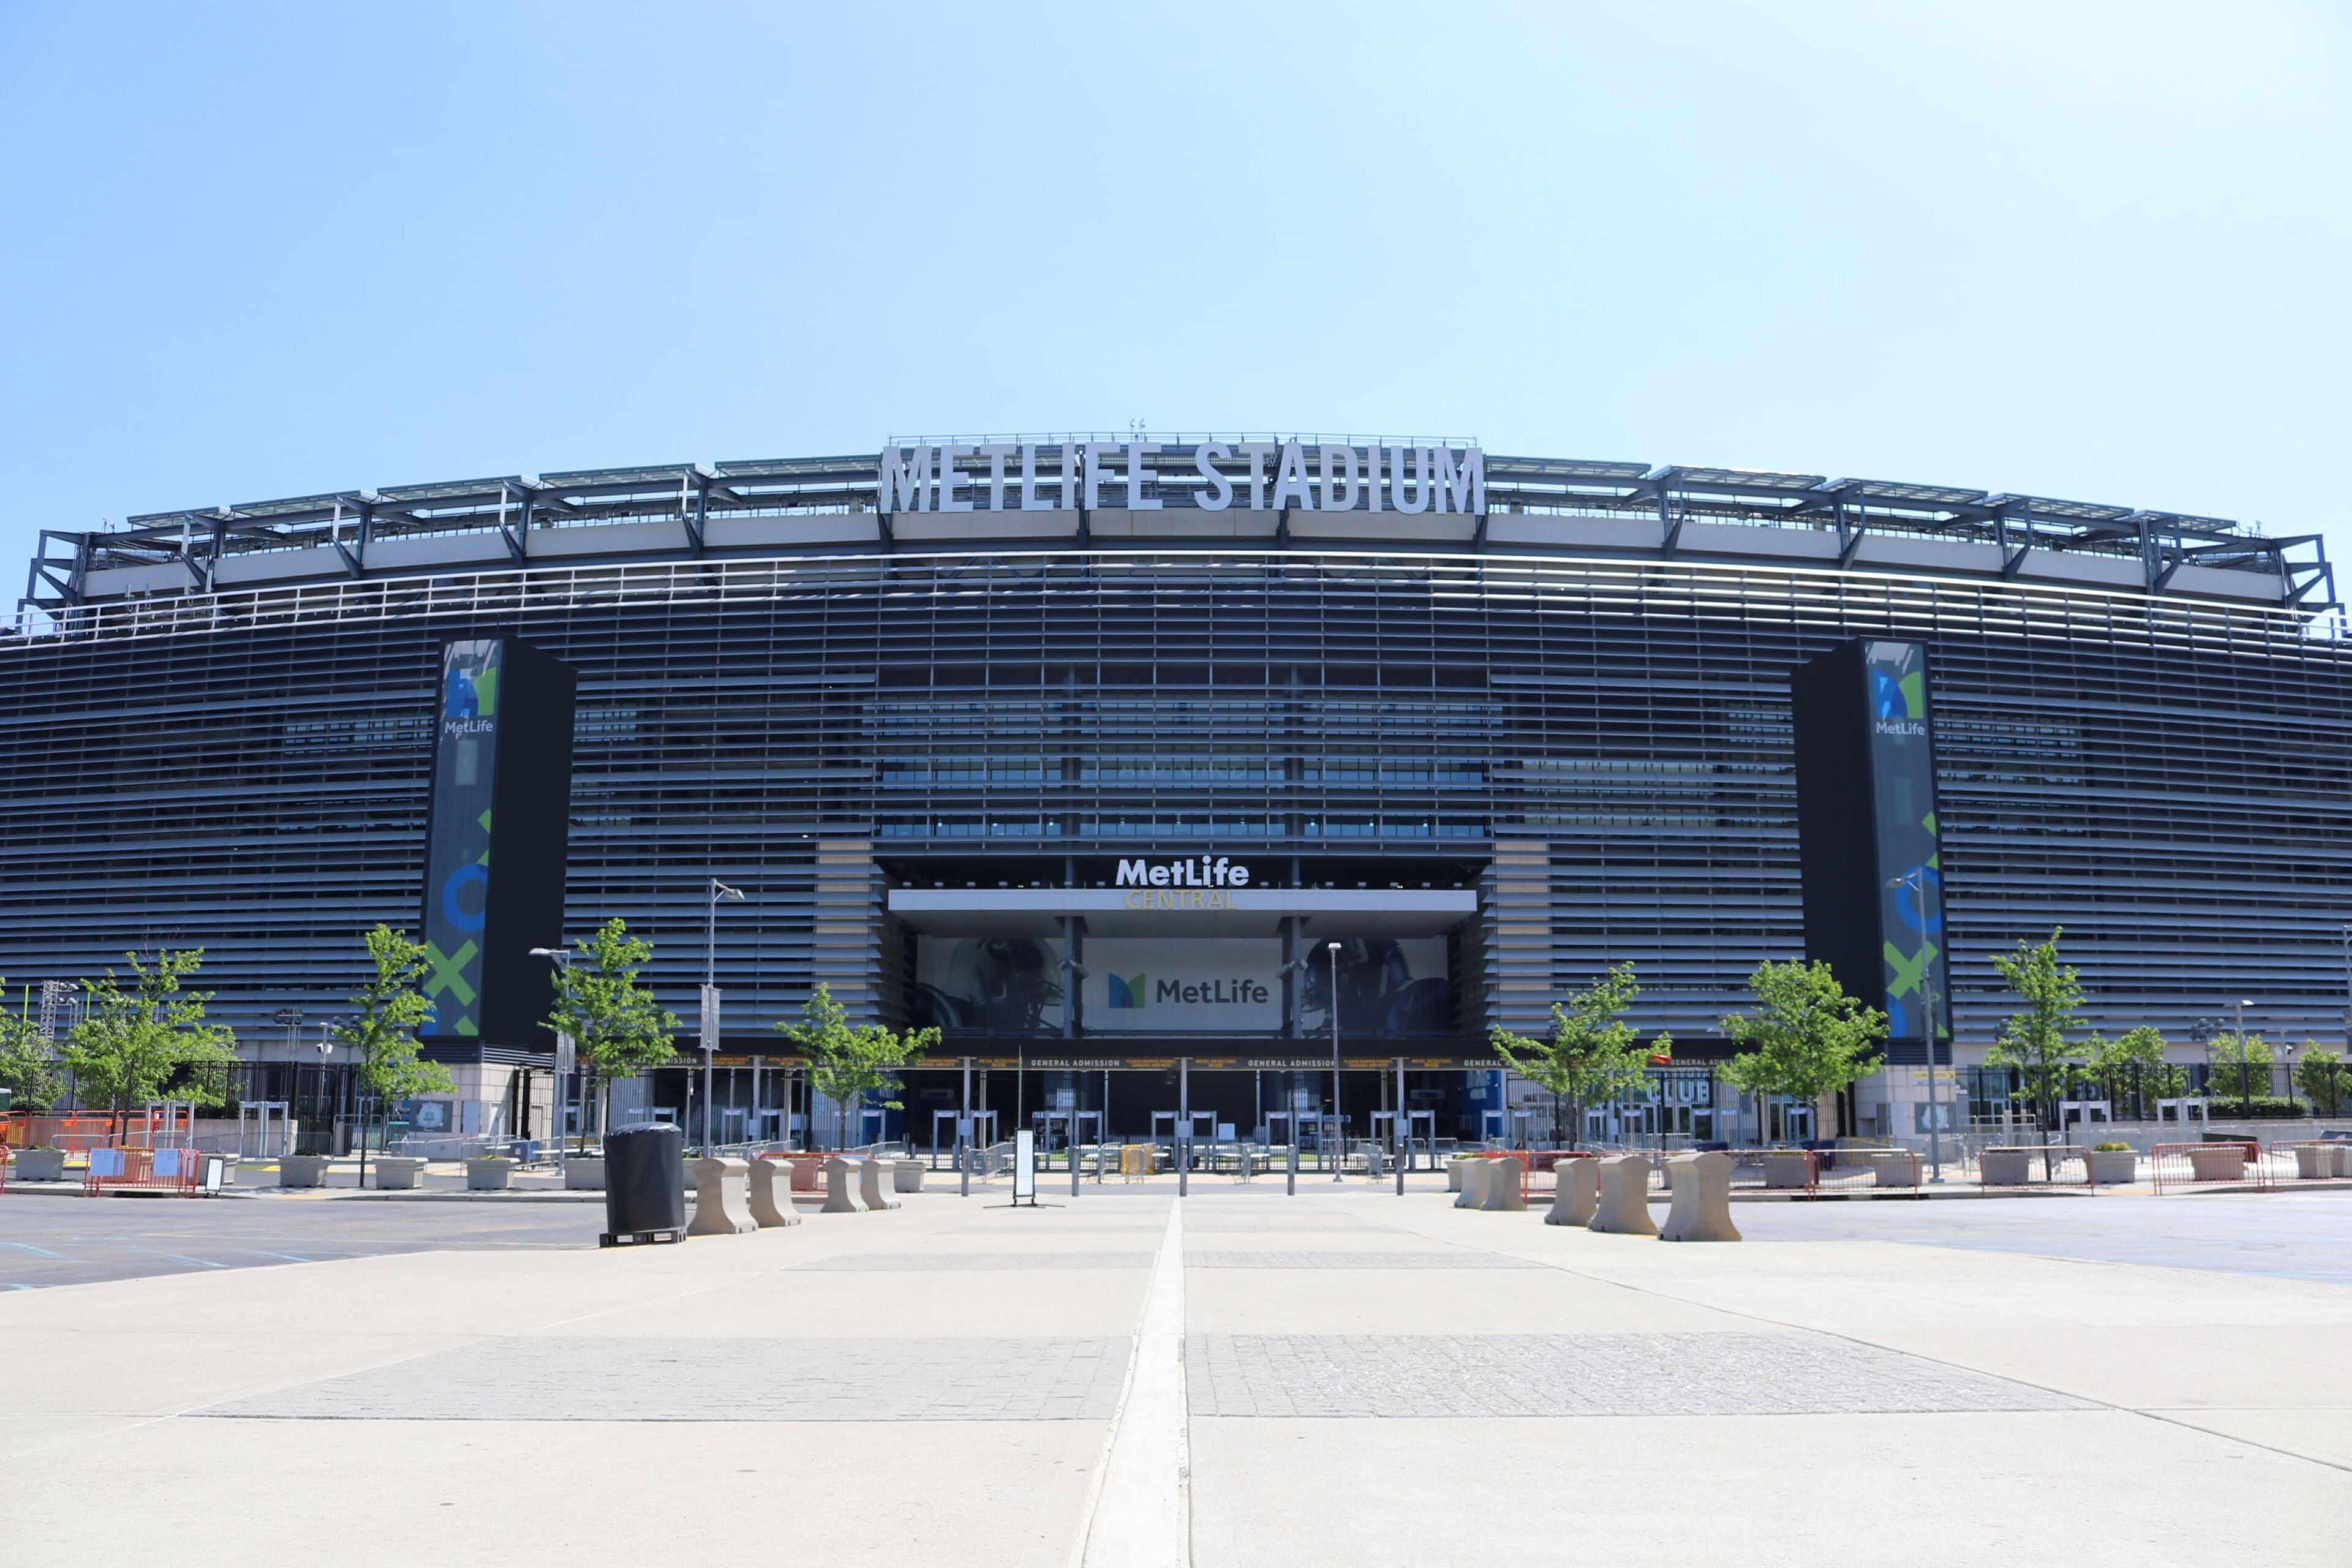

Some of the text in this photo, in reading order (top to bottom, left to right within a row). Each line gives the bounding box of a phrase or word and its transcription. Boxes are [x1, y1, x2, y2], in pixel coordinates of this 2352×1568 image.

[880, 441, 1486, 515] METLIFE STADIUM
[445, 720, 493, 734] MetLife
[1876, 721, 1925, 736] MetLife
[1115, 855, 1250, 886] MetLife
[1126, 889, 1238, 910] CENTRAL
[1156, 979, 1268, 1004] MetLife
